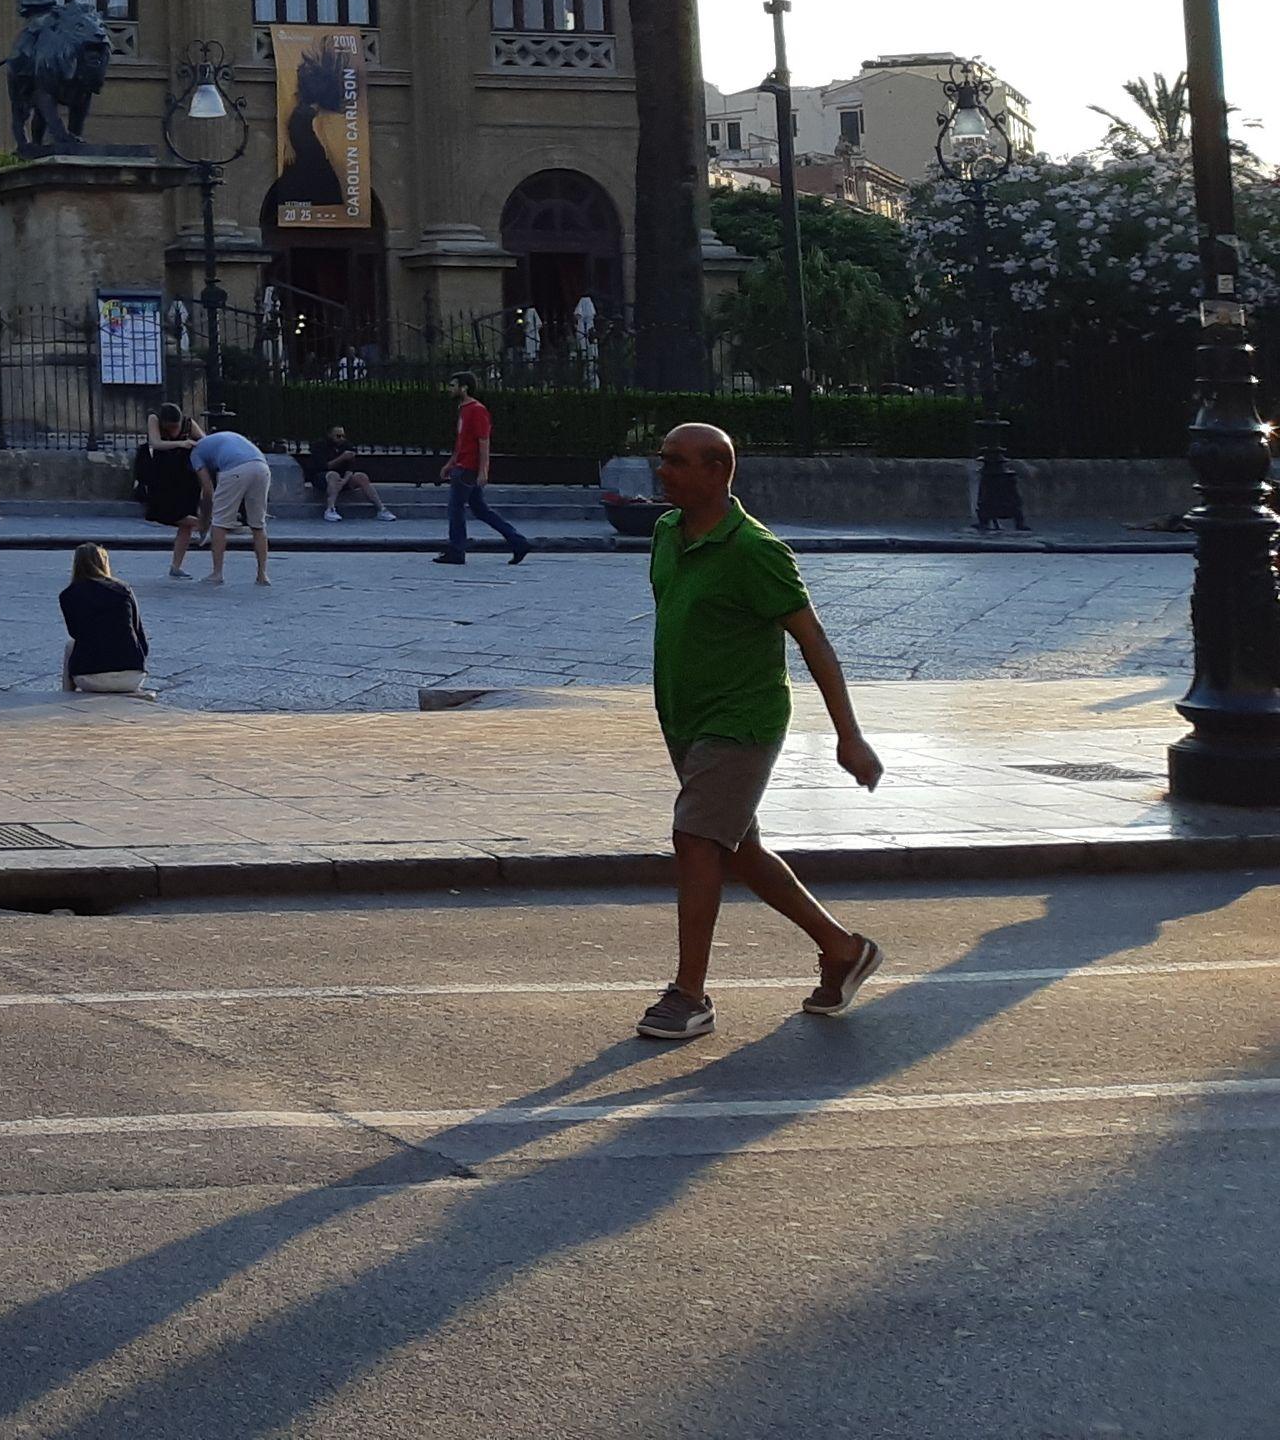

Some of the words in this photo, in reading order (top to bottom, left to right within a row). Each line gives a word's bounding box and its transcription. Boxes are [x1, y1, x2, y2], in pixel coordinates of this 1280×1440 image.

[343, 68, 358, 140] CARLSON
[284, 209, 296, 221] 20
[300, 209, 312, 221] 25
[346, 147, 359, 217] CAROLYN
